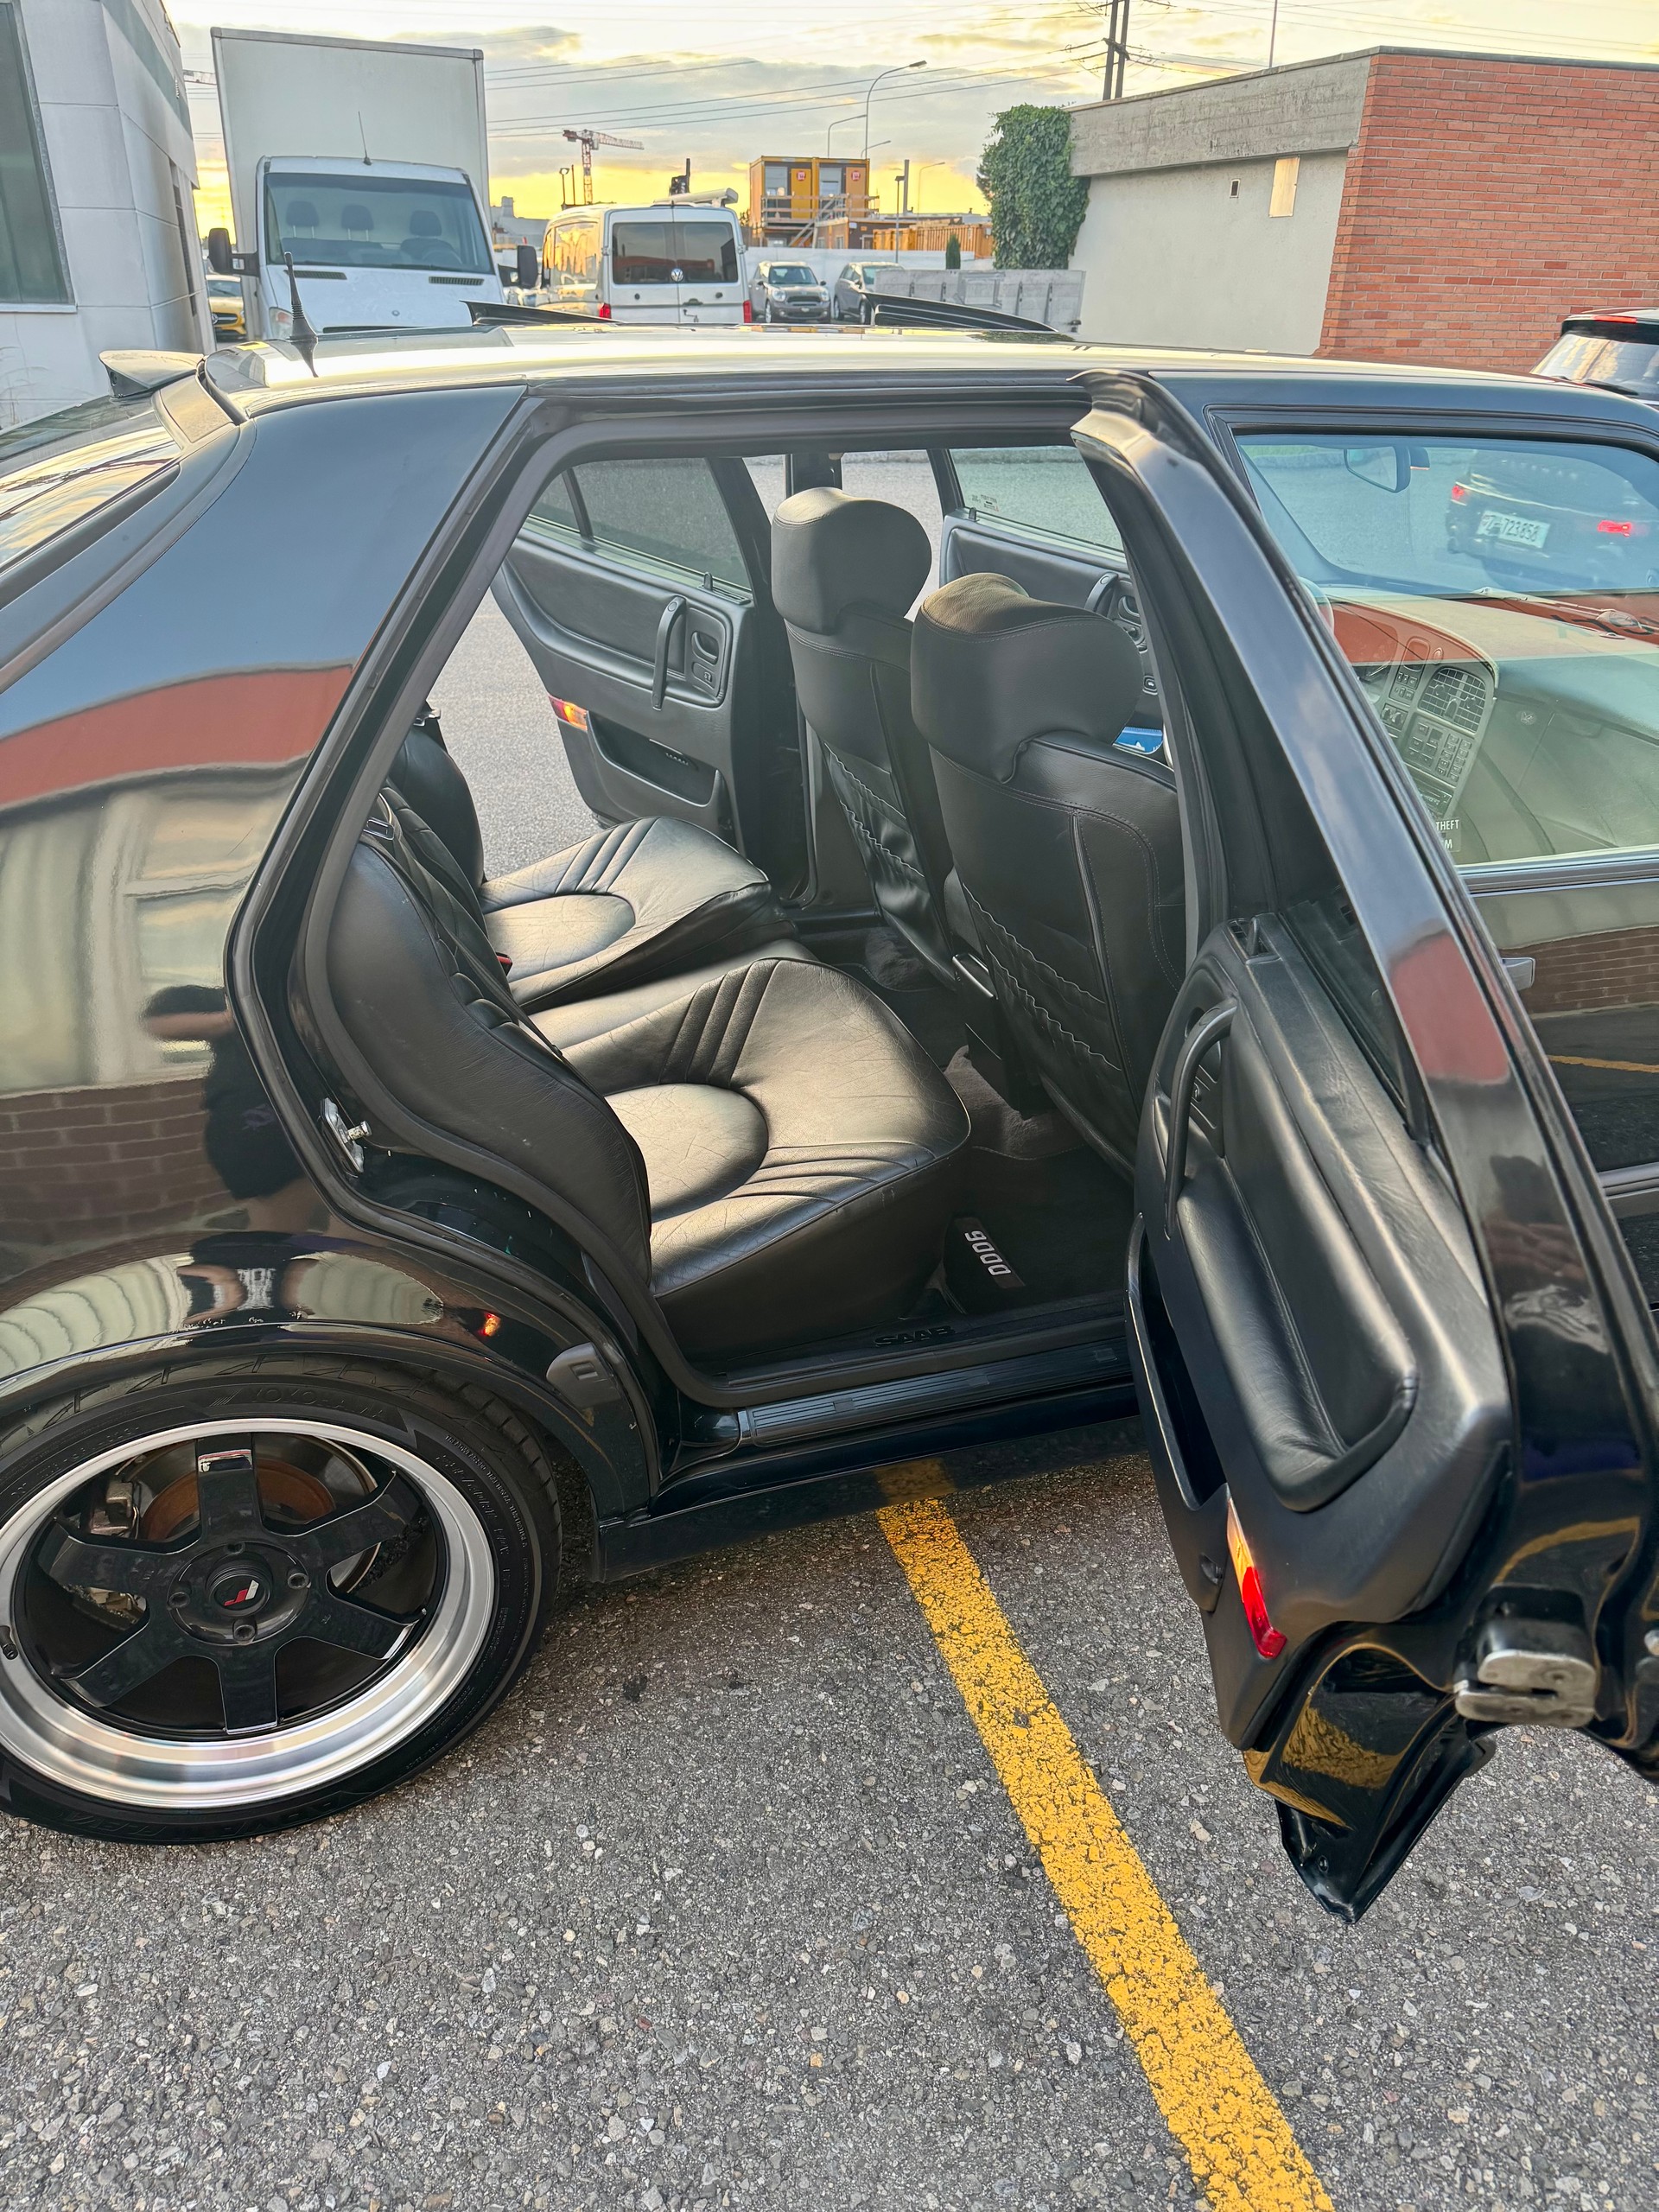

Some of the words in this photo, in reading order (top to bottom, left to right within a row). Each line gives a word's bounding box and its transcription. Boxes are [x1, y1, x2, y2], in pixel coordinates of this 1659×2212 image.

[1436, 819, 1459, 830] THEFT
[964, 1230, 1012, 1276] 9000
[874, 1325, 956, 1348] SAAB
